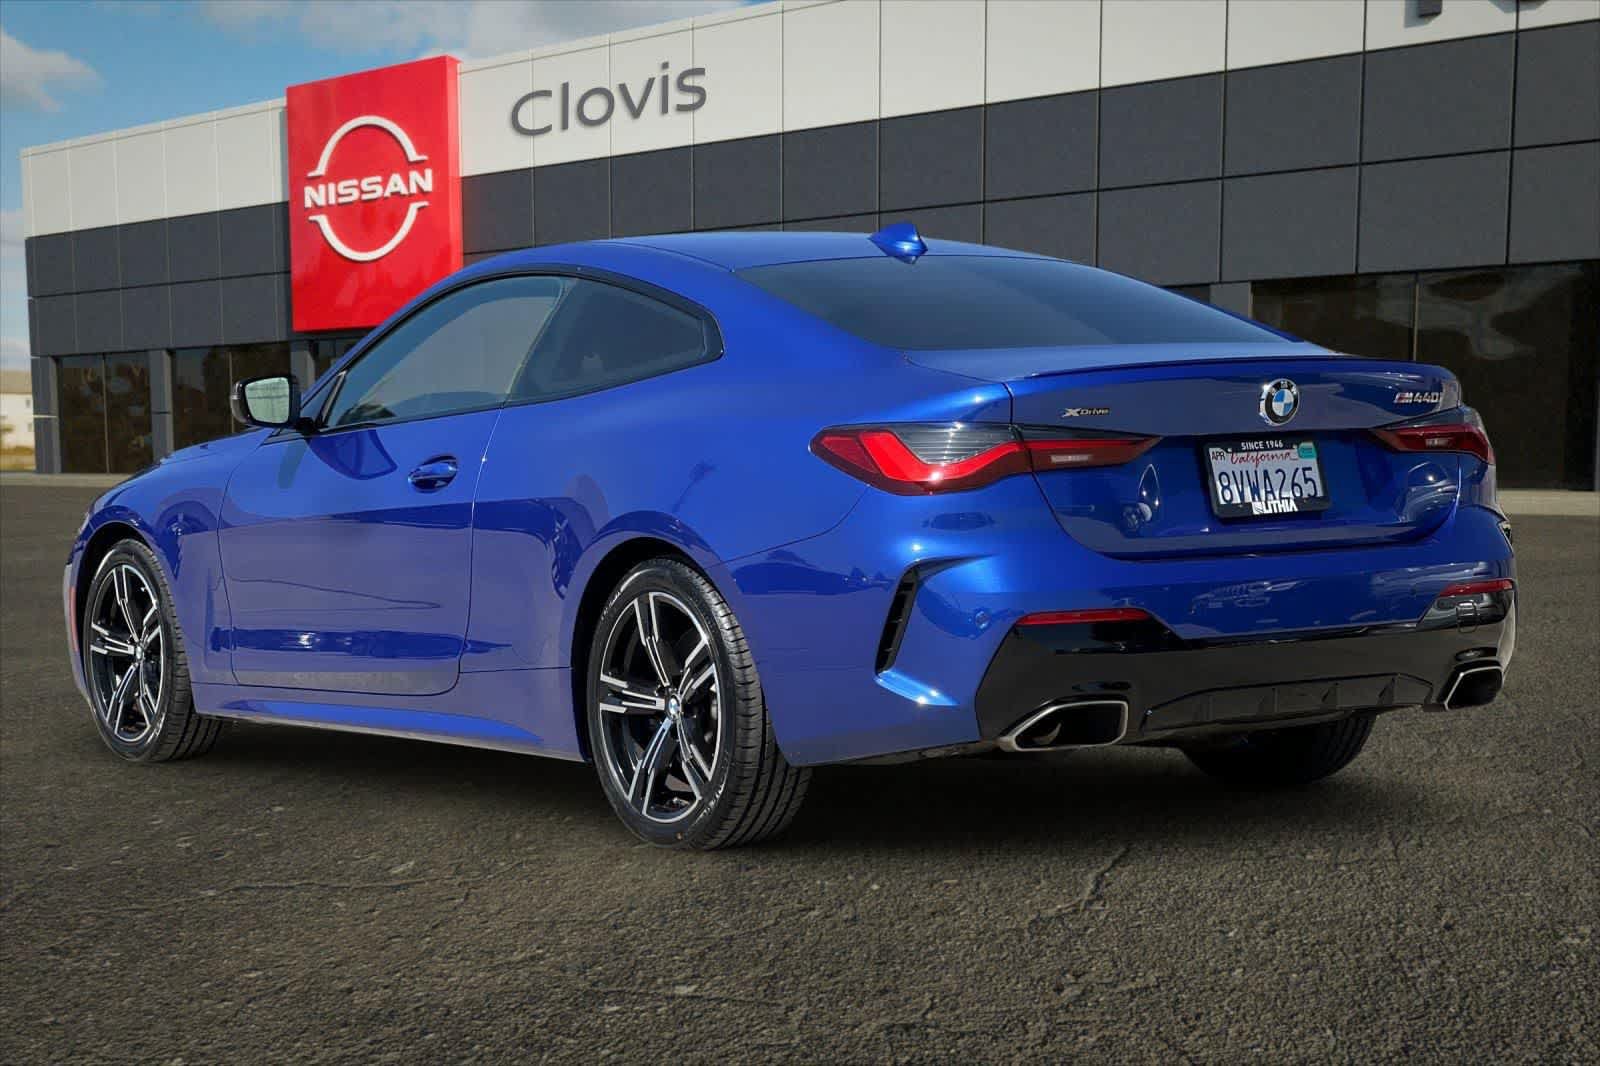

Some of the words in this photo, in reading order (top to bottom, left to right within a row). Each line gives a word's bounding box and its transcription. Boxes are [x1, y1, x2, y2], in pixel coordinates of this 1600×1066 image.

[511, 61, 707, 136] Clovis
[304, 168, 433, 208] NISSAN
[1241, 441, 1264, 450] SINCE
[1265, 440, 1284, 448] 1946
[1211, 450, 1226, 460] APR
[1230, 451, 1297, 467] California
[1218, 467, 1318, 504] 8VWA265
[1262, 499, 1298, 513] LITHIA
